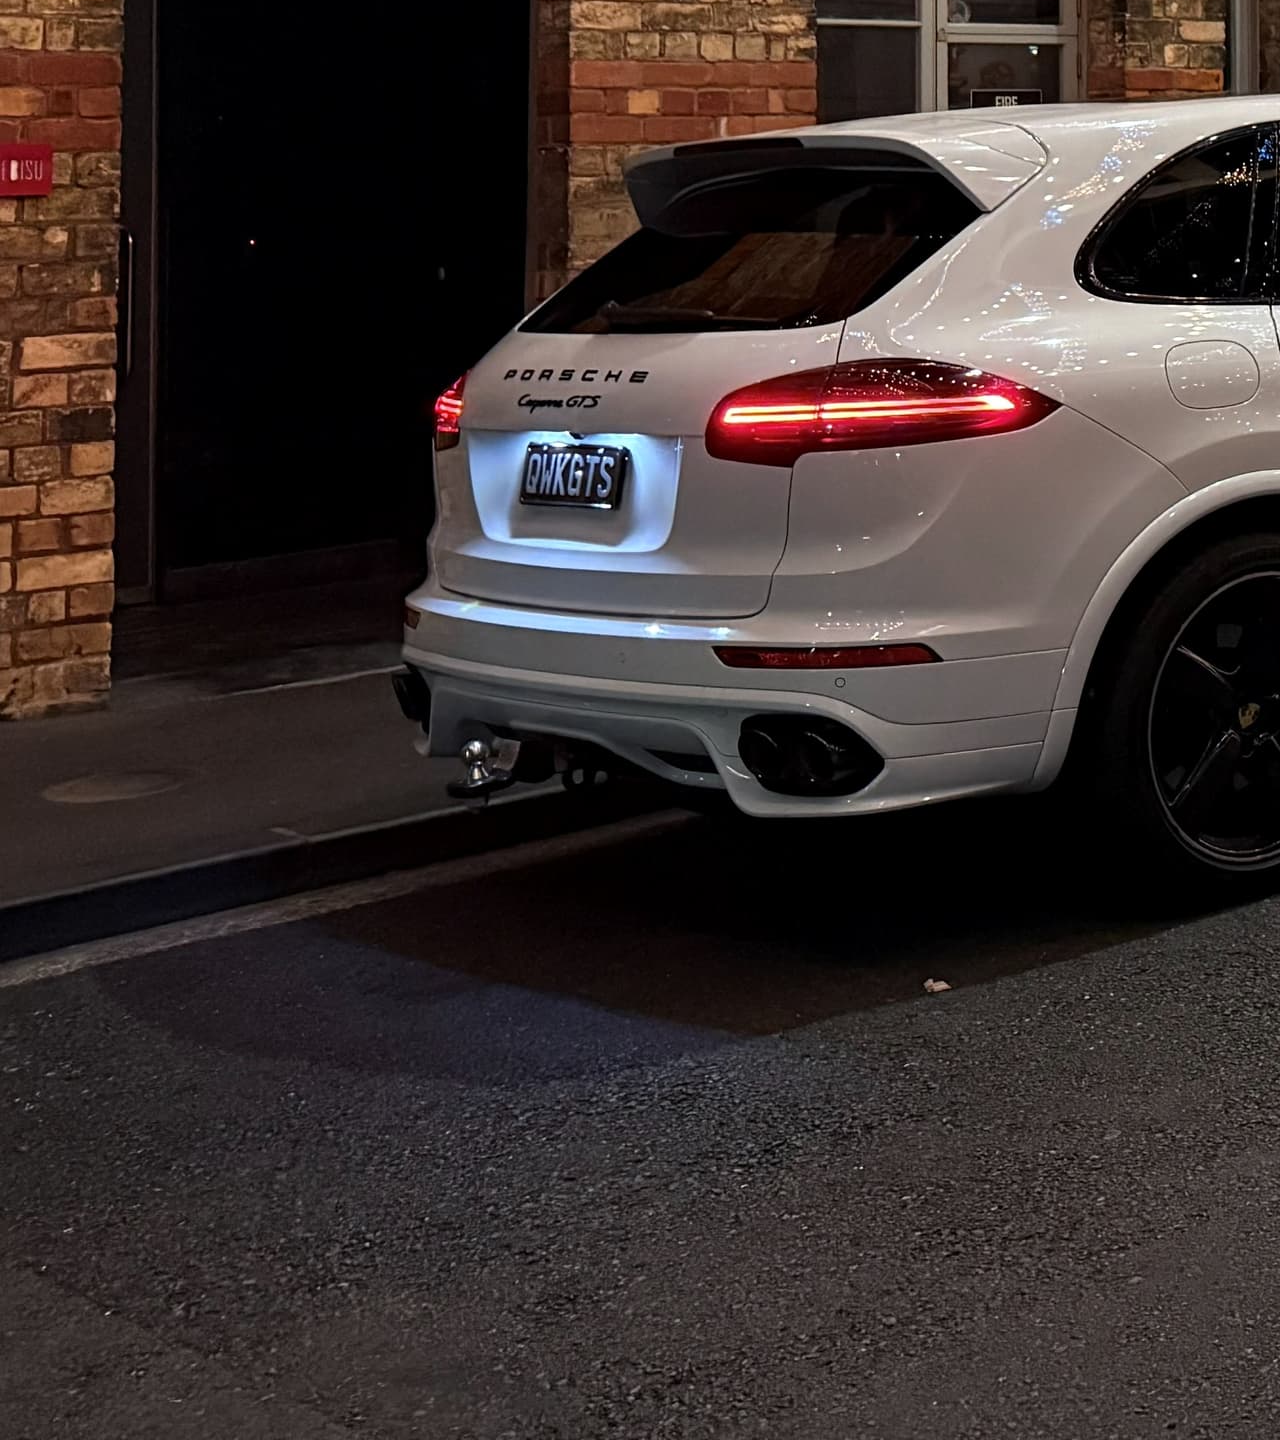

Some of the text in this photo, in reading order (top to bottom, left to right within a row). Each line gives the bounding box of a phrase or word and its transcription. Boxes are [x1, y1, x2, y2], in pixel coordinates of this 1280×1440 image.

[504, 369, 649, 383] PORSCHE
[566, 395, 602, 408] GTS
[525, 453, 615, 498] QWKGTS
